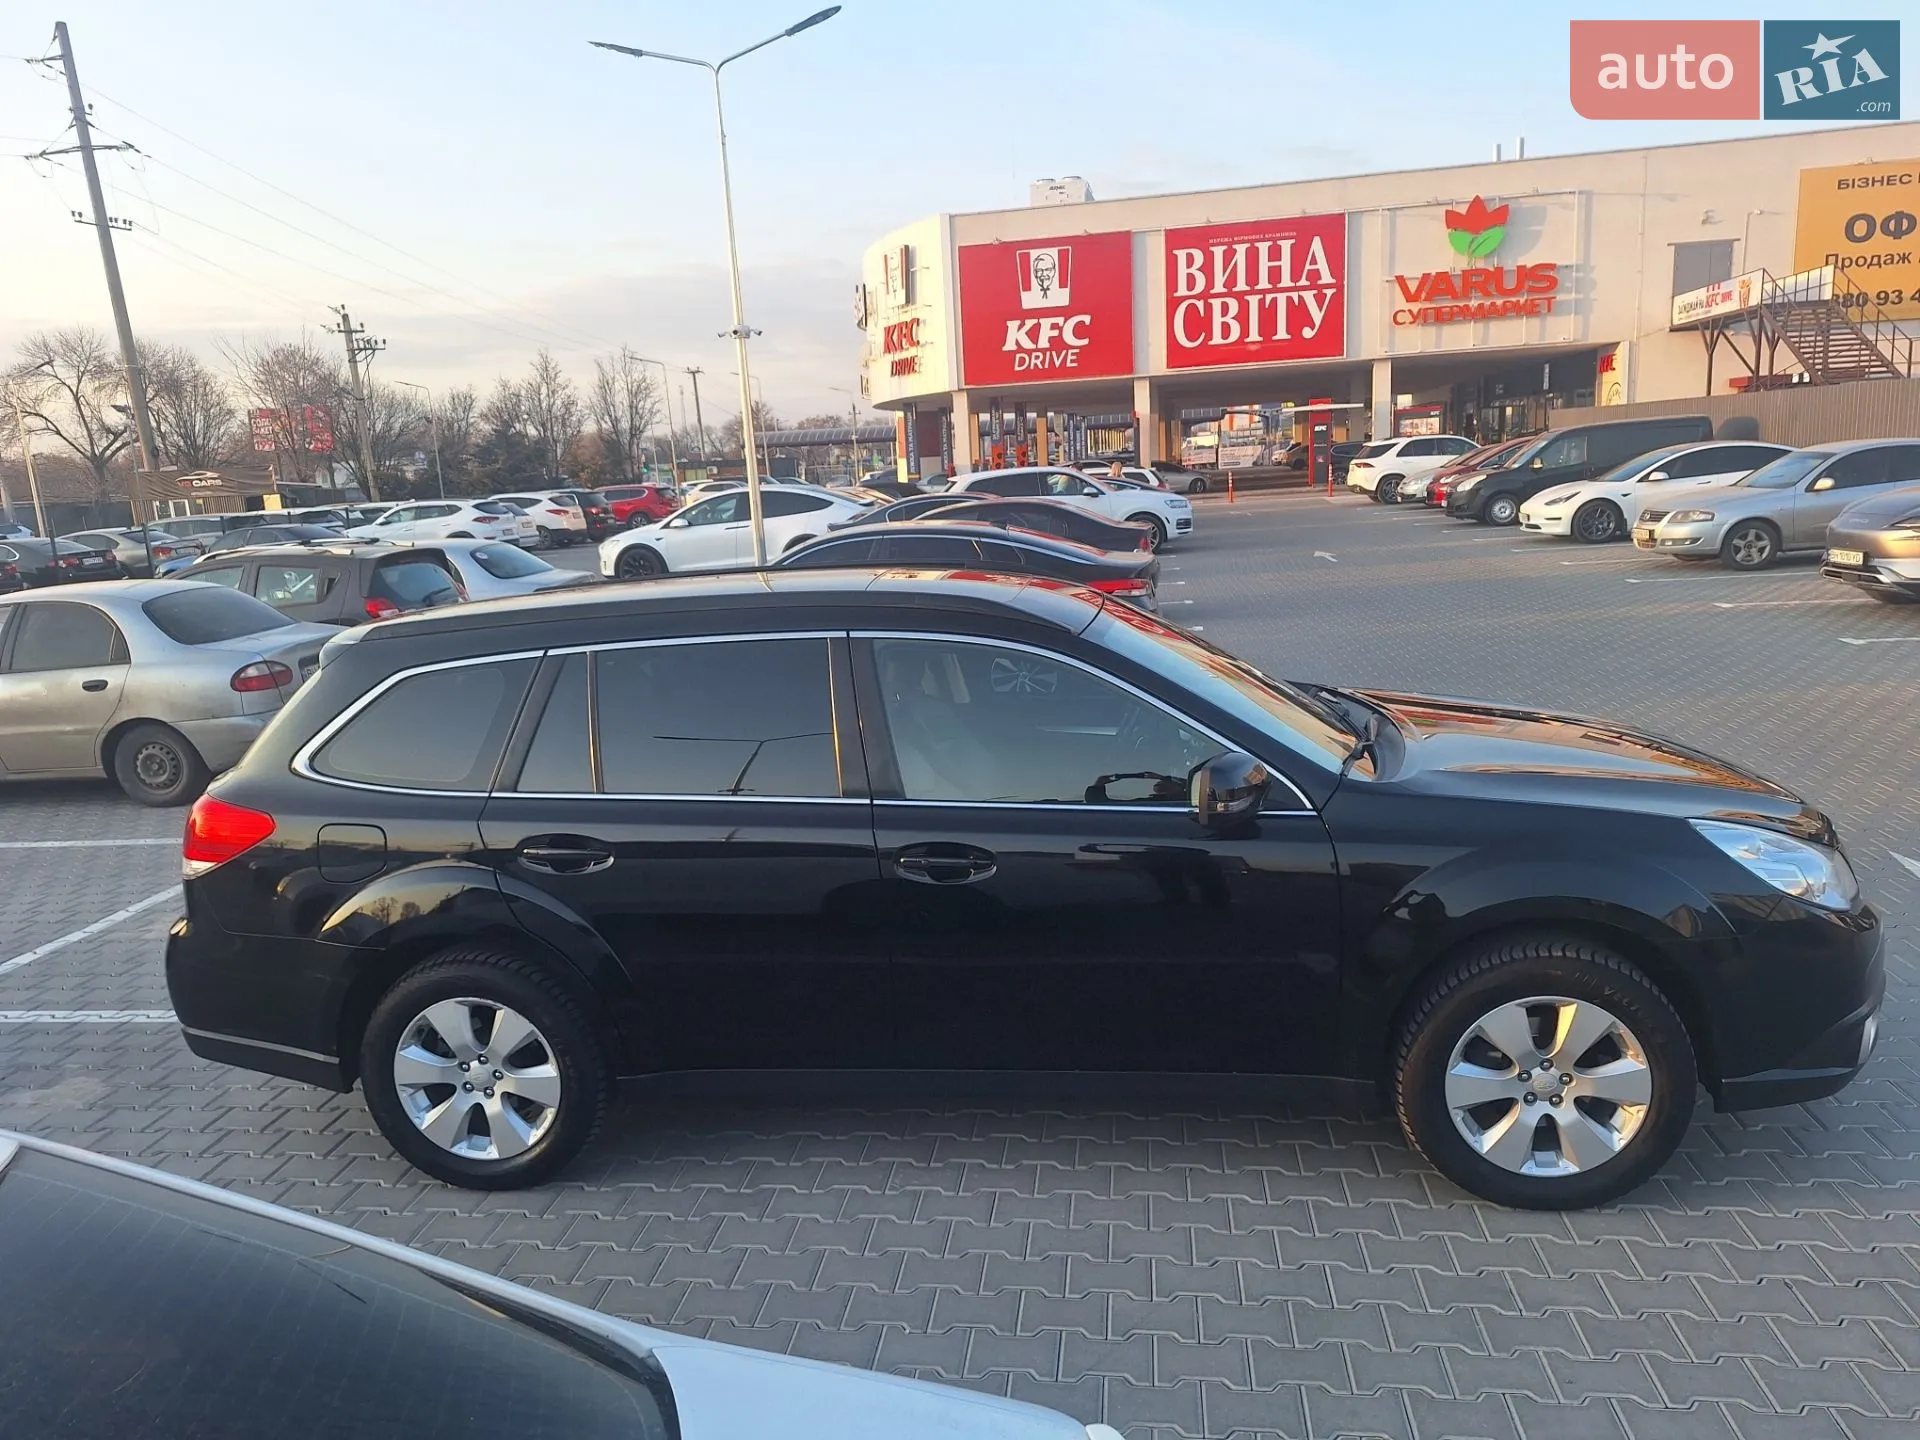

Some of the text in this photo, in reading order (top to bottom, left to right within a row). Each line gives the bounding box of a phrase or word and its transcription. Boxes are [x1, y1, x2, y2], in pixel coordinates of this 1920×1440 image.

[1837, 173, 1913, 190] БІЗНЕС
[1844, 210, 1918, 243] ОФ
[1172, 235, 1337, 297] ВИНА
[1825, 252, 1912, 272] Продаж
[1394, 263, 1559, 303] VARUS
[1705, 292, 1720, 309] KFC
[1876, 289, 1904, 306] 93
[1173, 288, 1337, 348] СВІТУ
[1392, 296, 1557, 326] СУПЕРМАРКЕТ
[883, 317, 920, 355] KFC
[1002, 314, 1092, 351] KFC
[890, 355, 918, 378] DRIVE
[1014, 349, 1080, 371] DRIVE
[1600, 353, 1616, 374] KFC
[192, 479, 222, 487] CARS
